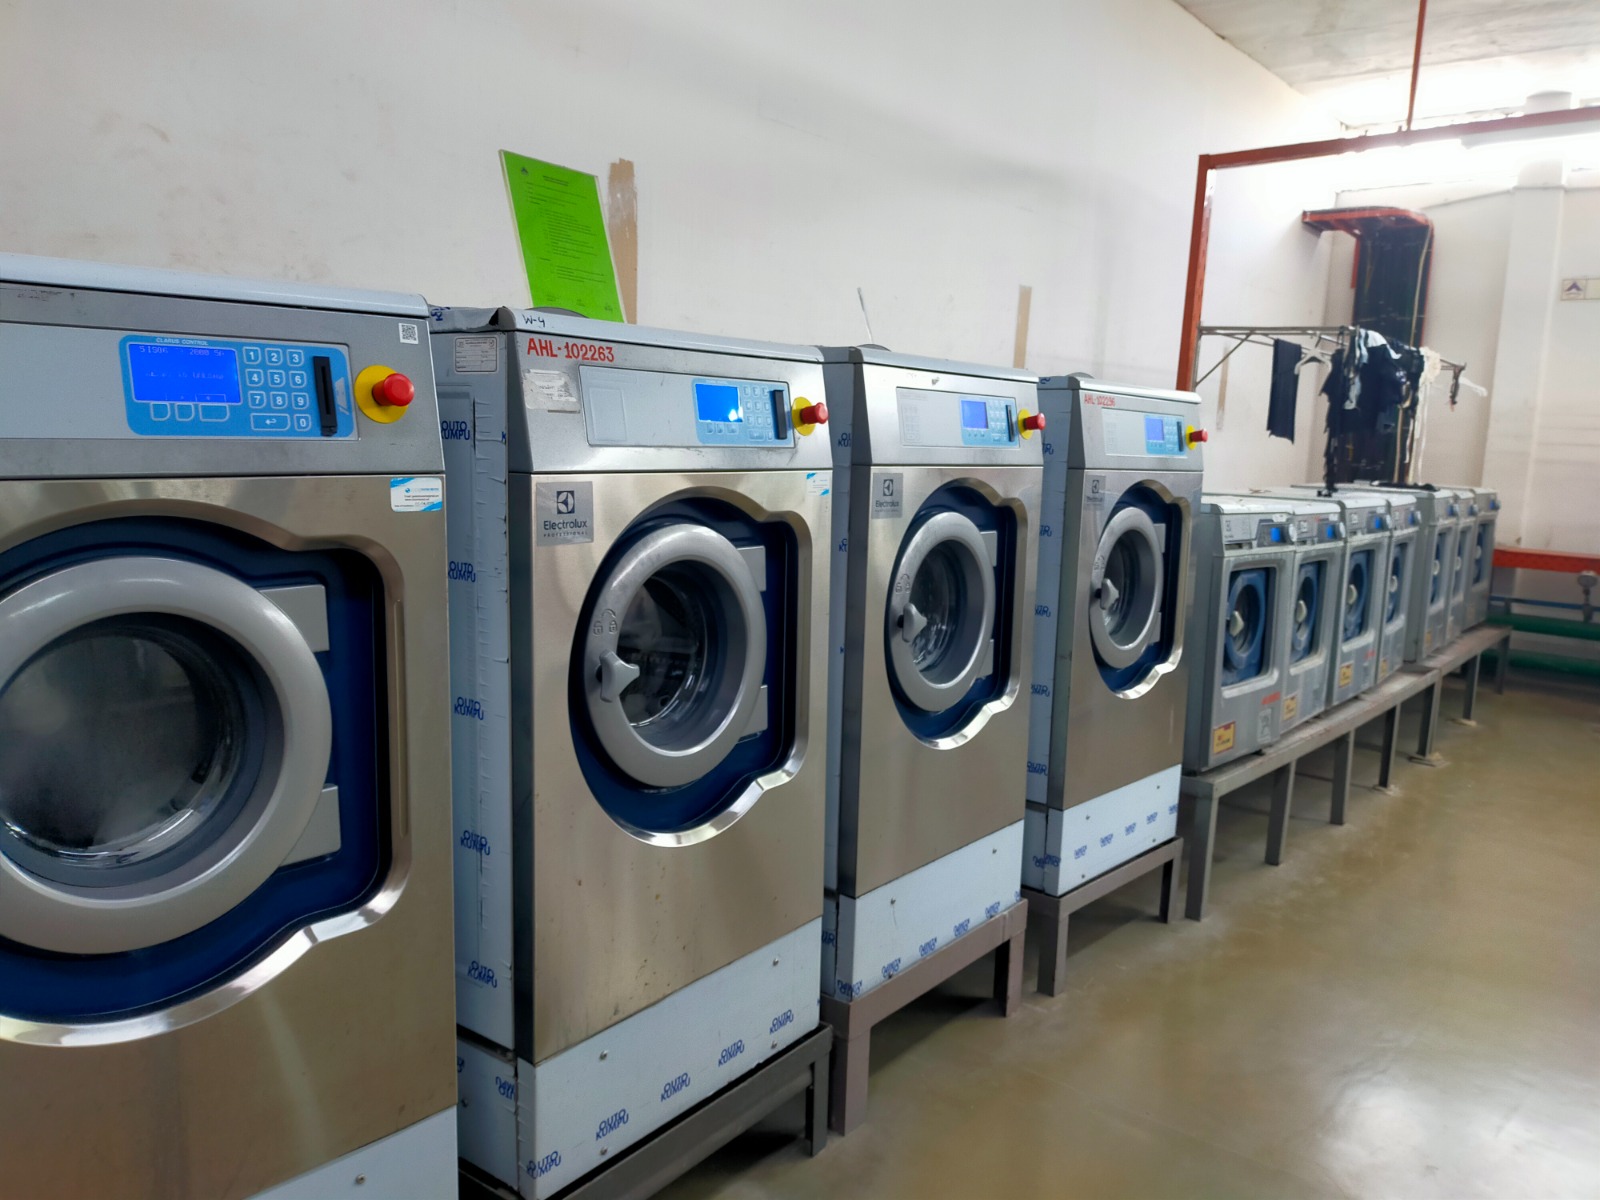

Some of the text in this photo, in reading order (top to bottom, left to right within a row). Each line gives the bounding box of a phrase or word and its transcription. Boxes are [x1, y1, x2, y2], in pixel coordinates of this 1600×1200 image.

[249, 351, 299, 363] 1 2 3
[527, 338, 615, 363] AHL-102263
[251, 373, 302, 384] 4 5 6
[253, 395, 304, 406] 7 8 9
[300, 418, 307, 427] 0
[441, 420, 468, 432] OUTO
[543, 519, 588, 531] Electrolux
[450, 560, 474, 573] OUTO
[457, 696, 481, 711] OUTO
[771, 1009, 793, 1027] OUTO
[720, 1039, 744, 1059] OUTO
[660, 1076, 691, 1102] KUMPU
[663, 1072, 689, 1093] OUTO
[595, 1112, 629, 1141] KUMPU
[599, 1108, 627, 1132] OUTO
